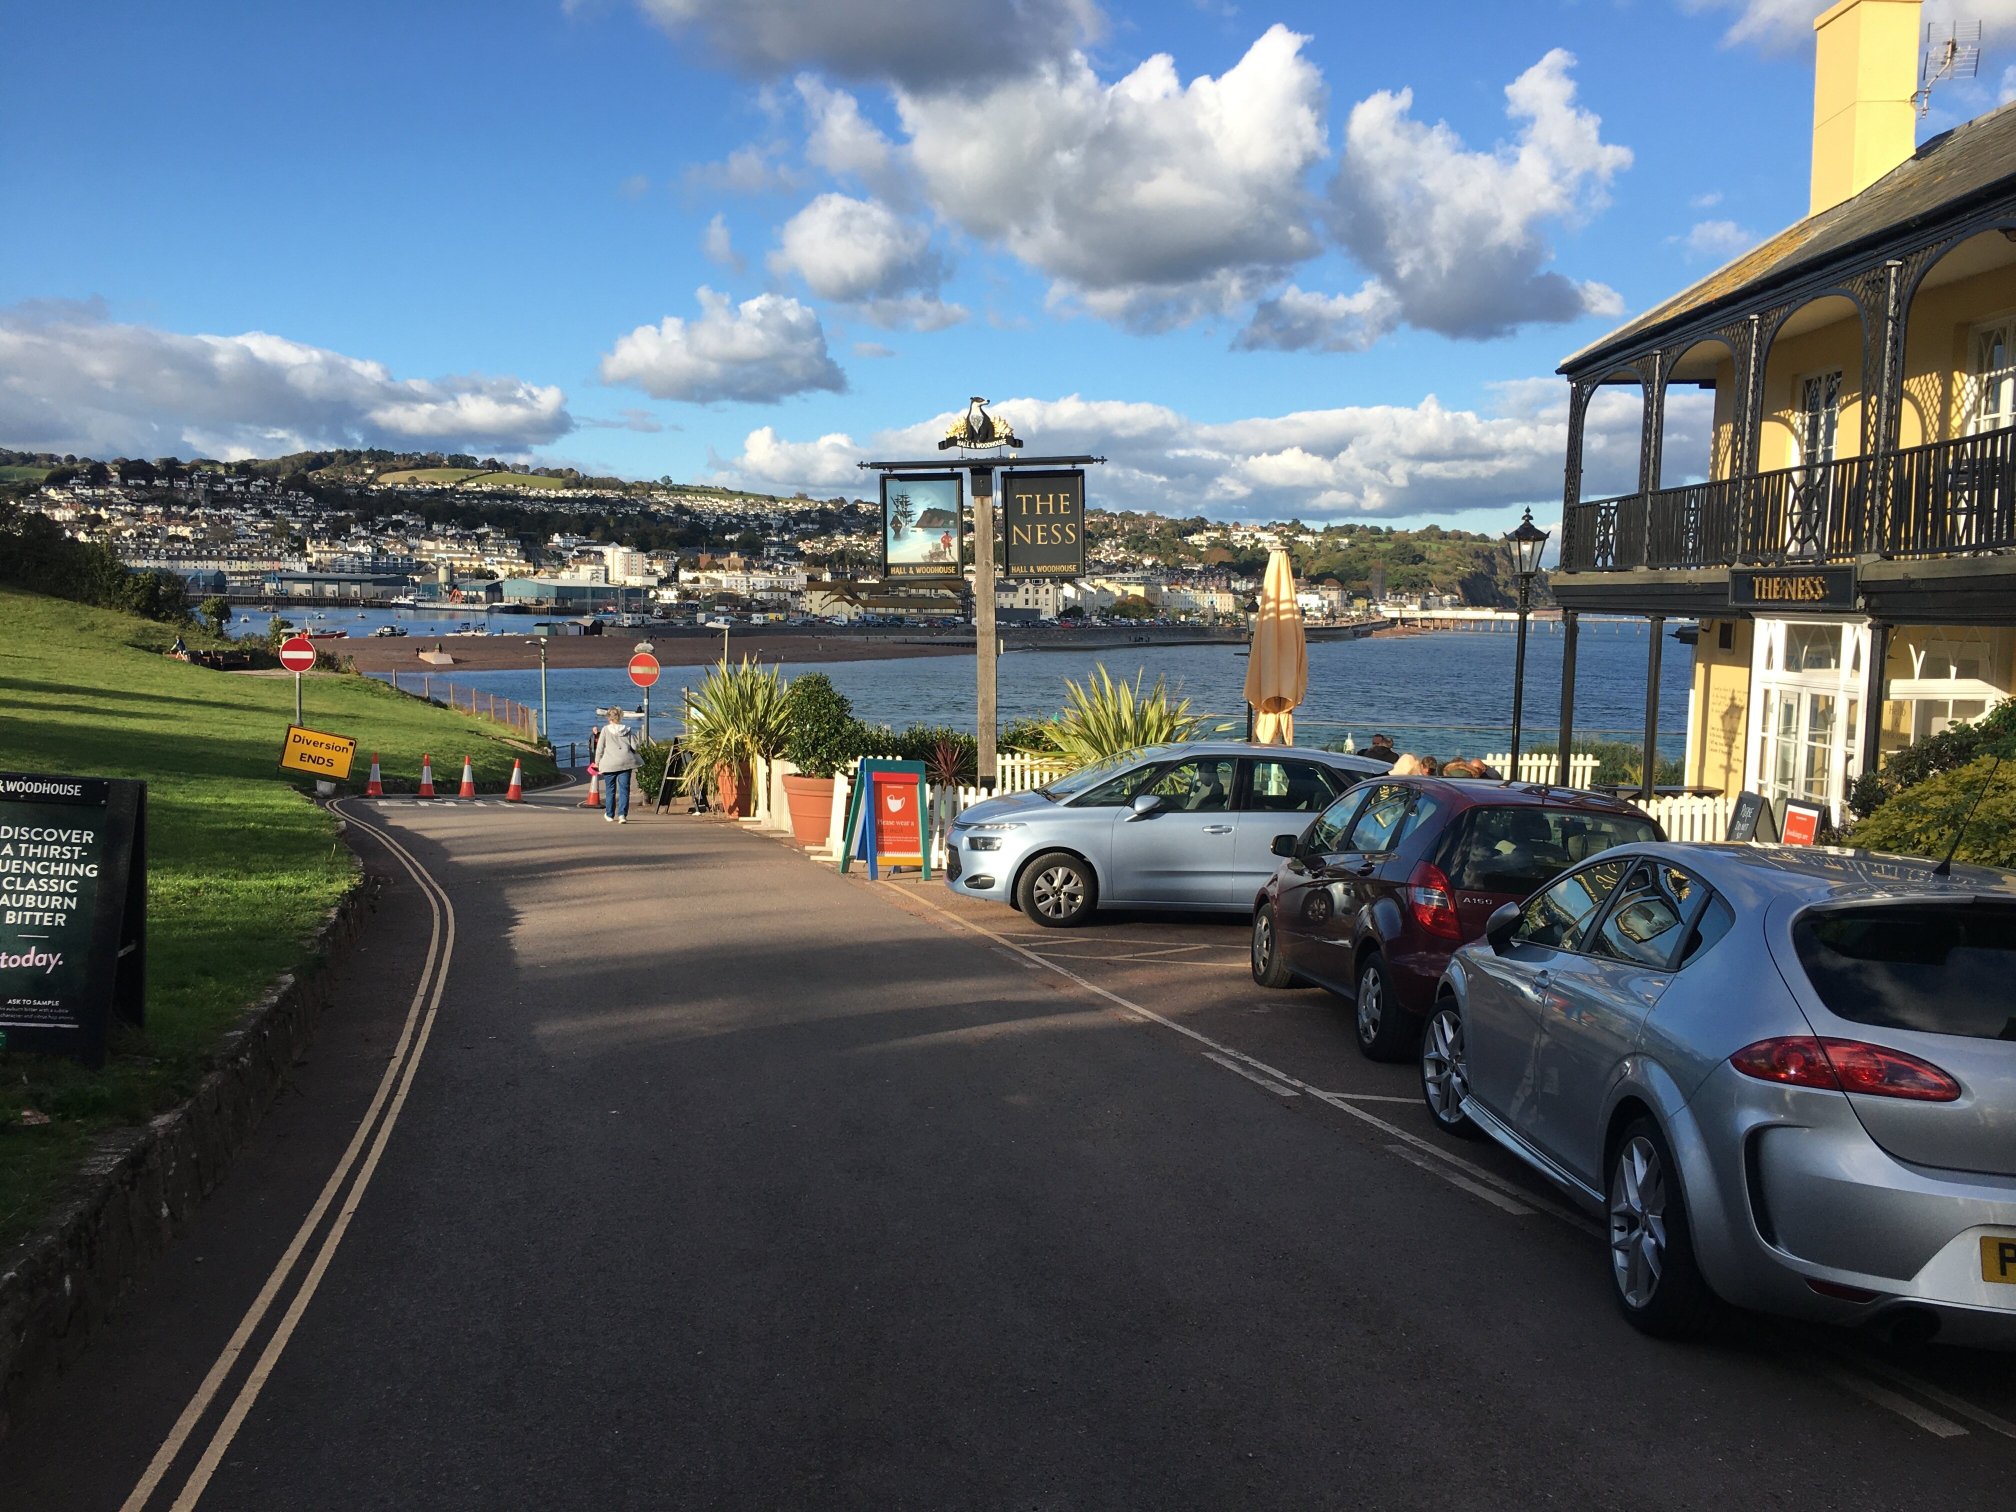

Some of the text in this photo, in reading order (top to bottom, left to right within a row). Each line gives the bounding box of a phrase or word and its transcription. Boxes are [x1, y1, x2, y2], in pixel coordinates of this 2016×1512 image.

[957, 440, 970, 448] HALL
[976, 439, 1007, 449] WOODHOUSE
[1015, 493, 1071, 515] THE
[1012, 523, 1077, 546] NESS
[891, 566, 906, 575] HALL
[916, 566, 956, 575] WOODHOUSE
[1011, 565, 1028, 573] HALL
[1037, 565, 1077, 573] WOODHOUSE
[1753, 576, 1825, 600] THE NESS
[292, 734, 349, 754] Diversion
[299, 753, 335, 768] ENDS
[6, 780, 82, 796] WOODHOUSE
[0, 825, 95, 844] DISCOVER
[0, 842, 88, 860] A THIRST-
[0, 859, 98, 878] UENCHING
[2, 876, 79, 893] CLASSIC
[0, 893, 77, 910] AUBURN
[5, 910, 67, 927] BITTER
[0, 945, 64, 974] today.
